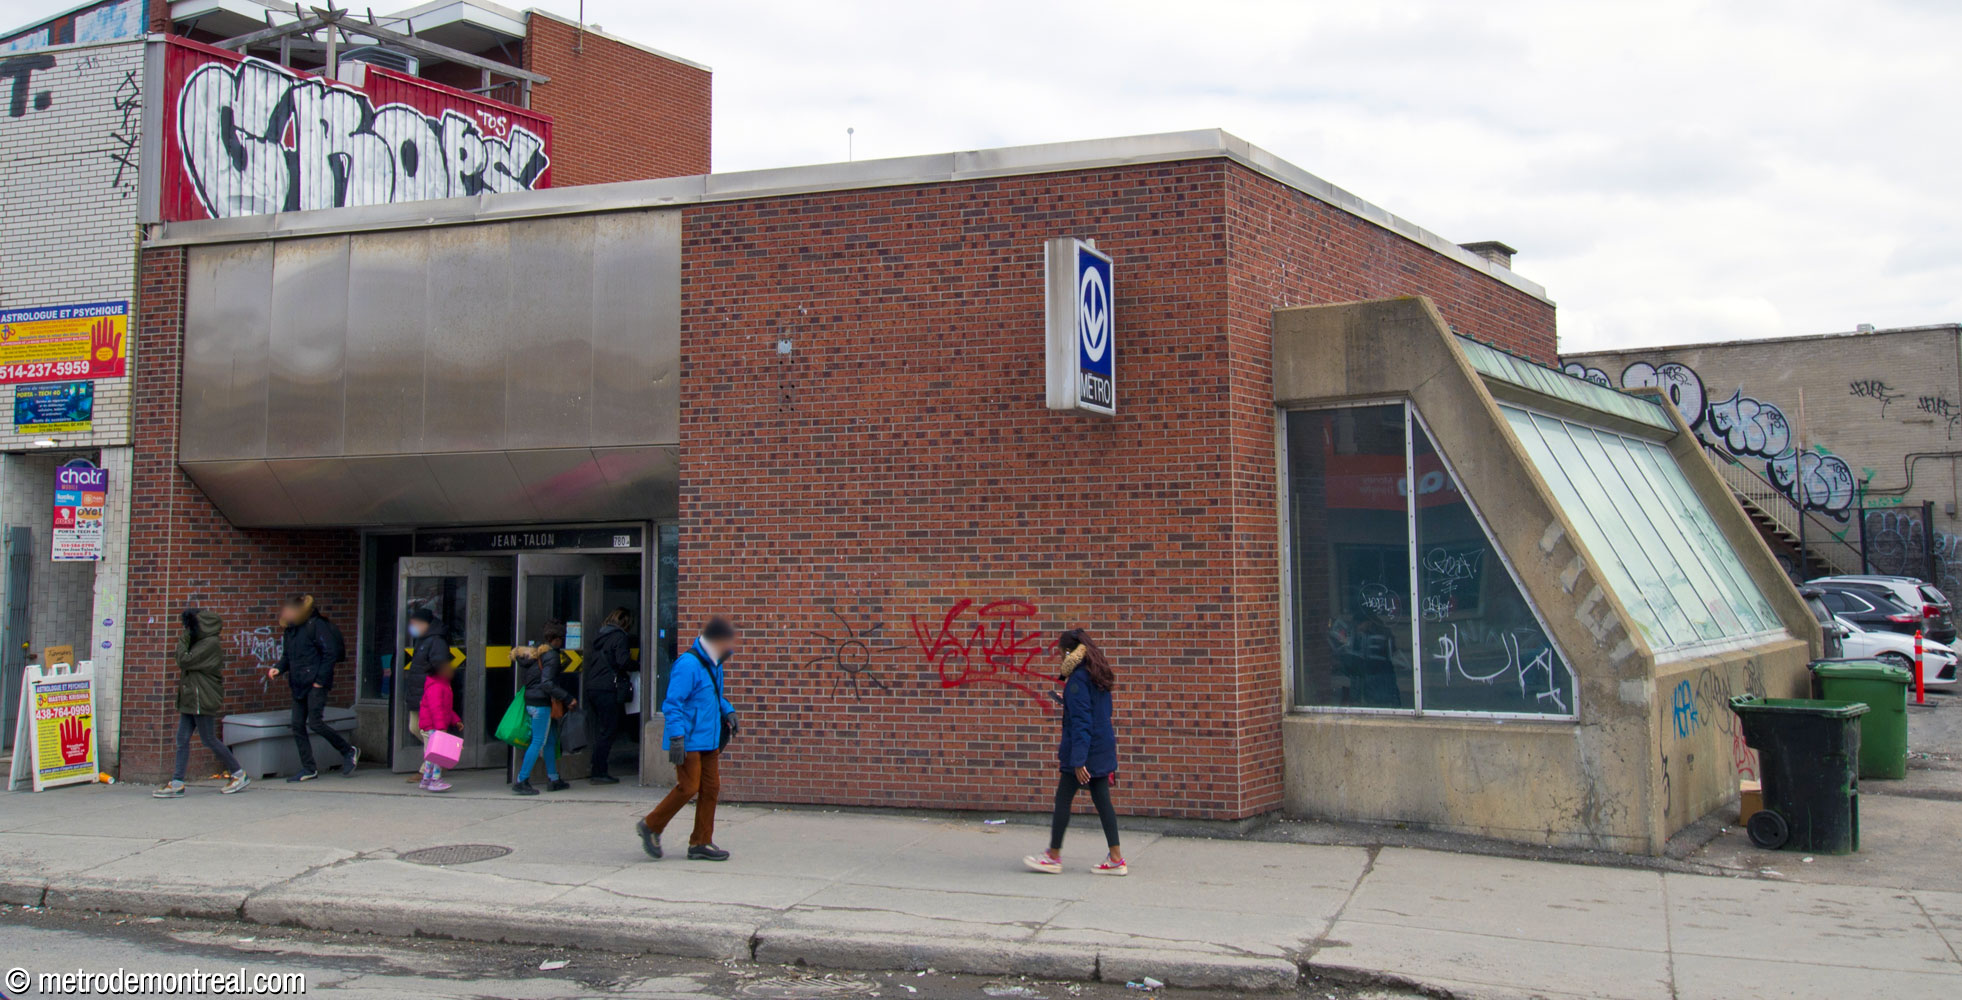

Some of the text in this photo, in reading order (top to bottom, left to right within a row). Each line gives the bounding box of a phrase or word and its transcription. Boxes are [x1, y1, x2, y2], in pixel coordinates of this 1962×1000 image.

[477, 109, 507, 136] TOS
[1, 305, 124, 323] ASTROLOGUE ET PSYCHIQUE
[0, 361, 90, 380] 514-237-5959
[60, 469, 103, 485] chatr
[36, 705, 91, 720] 438-764-0999
